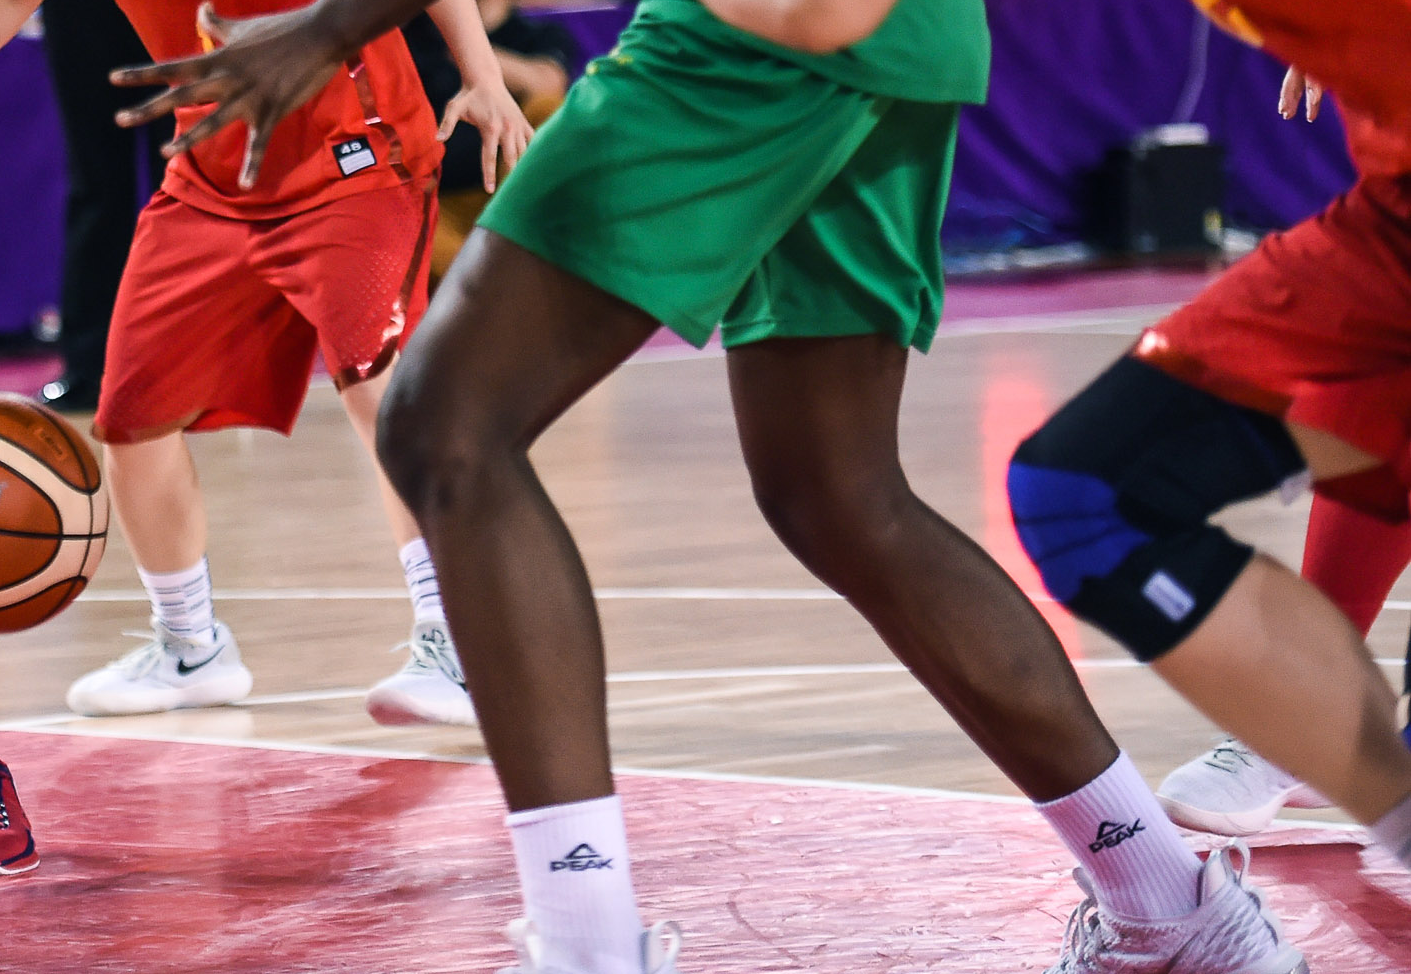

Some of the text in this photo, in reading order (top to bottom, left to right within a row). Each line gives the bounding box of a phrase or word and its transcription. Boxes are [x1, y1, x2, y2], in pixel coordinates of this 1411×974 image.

[341, 141, 362, 154] 48
[1089, 817, 1145, 854] PEAK
[549, 858, 614, 872] PEAK
